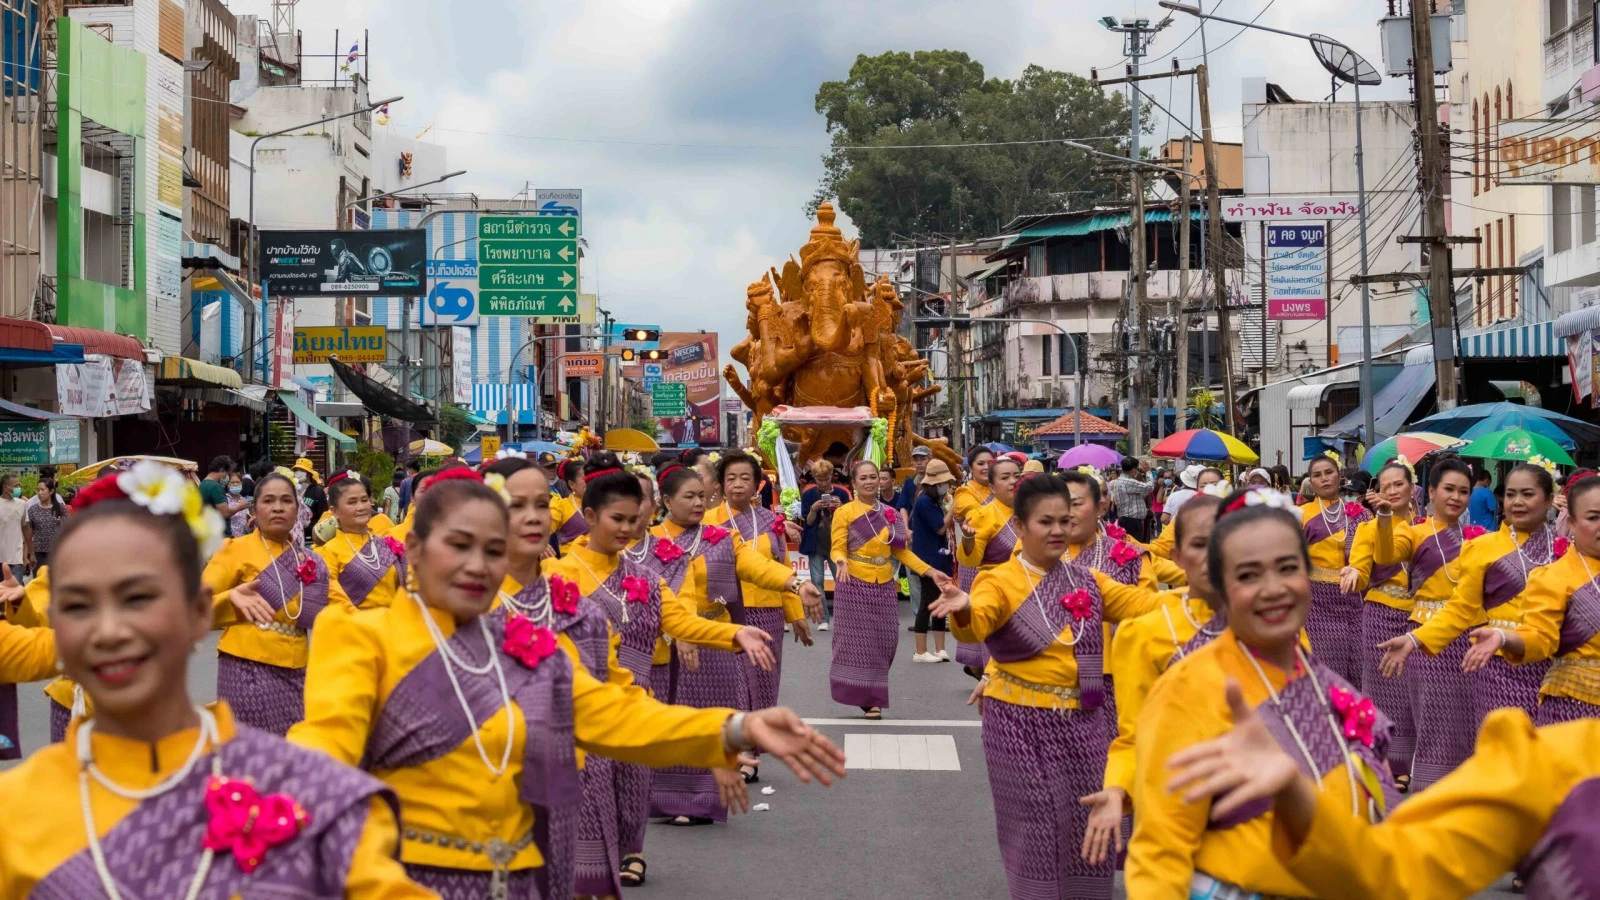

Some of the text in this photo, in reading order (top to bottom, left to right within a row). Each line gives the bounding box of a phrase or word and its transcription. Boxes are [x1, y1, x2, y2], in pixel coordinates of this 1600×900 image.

[1227, 201, 1361, 216] ทำฟัน จัดฟัน
[483, 219, 551, 234] สถานีตำรวจ
[1268, 229, 1323, 245] หู คอ จมูก
[484, 244, 551, 259] โรงพยาบาล
[491, 269, 545, 285] ศรีสะเกษ
[489, 295, 547, 311] พิพิธภัณฑ์
[1281, 303, 1311, 312] นงพร
[294, 327, 383, 351] นิยมไทย
